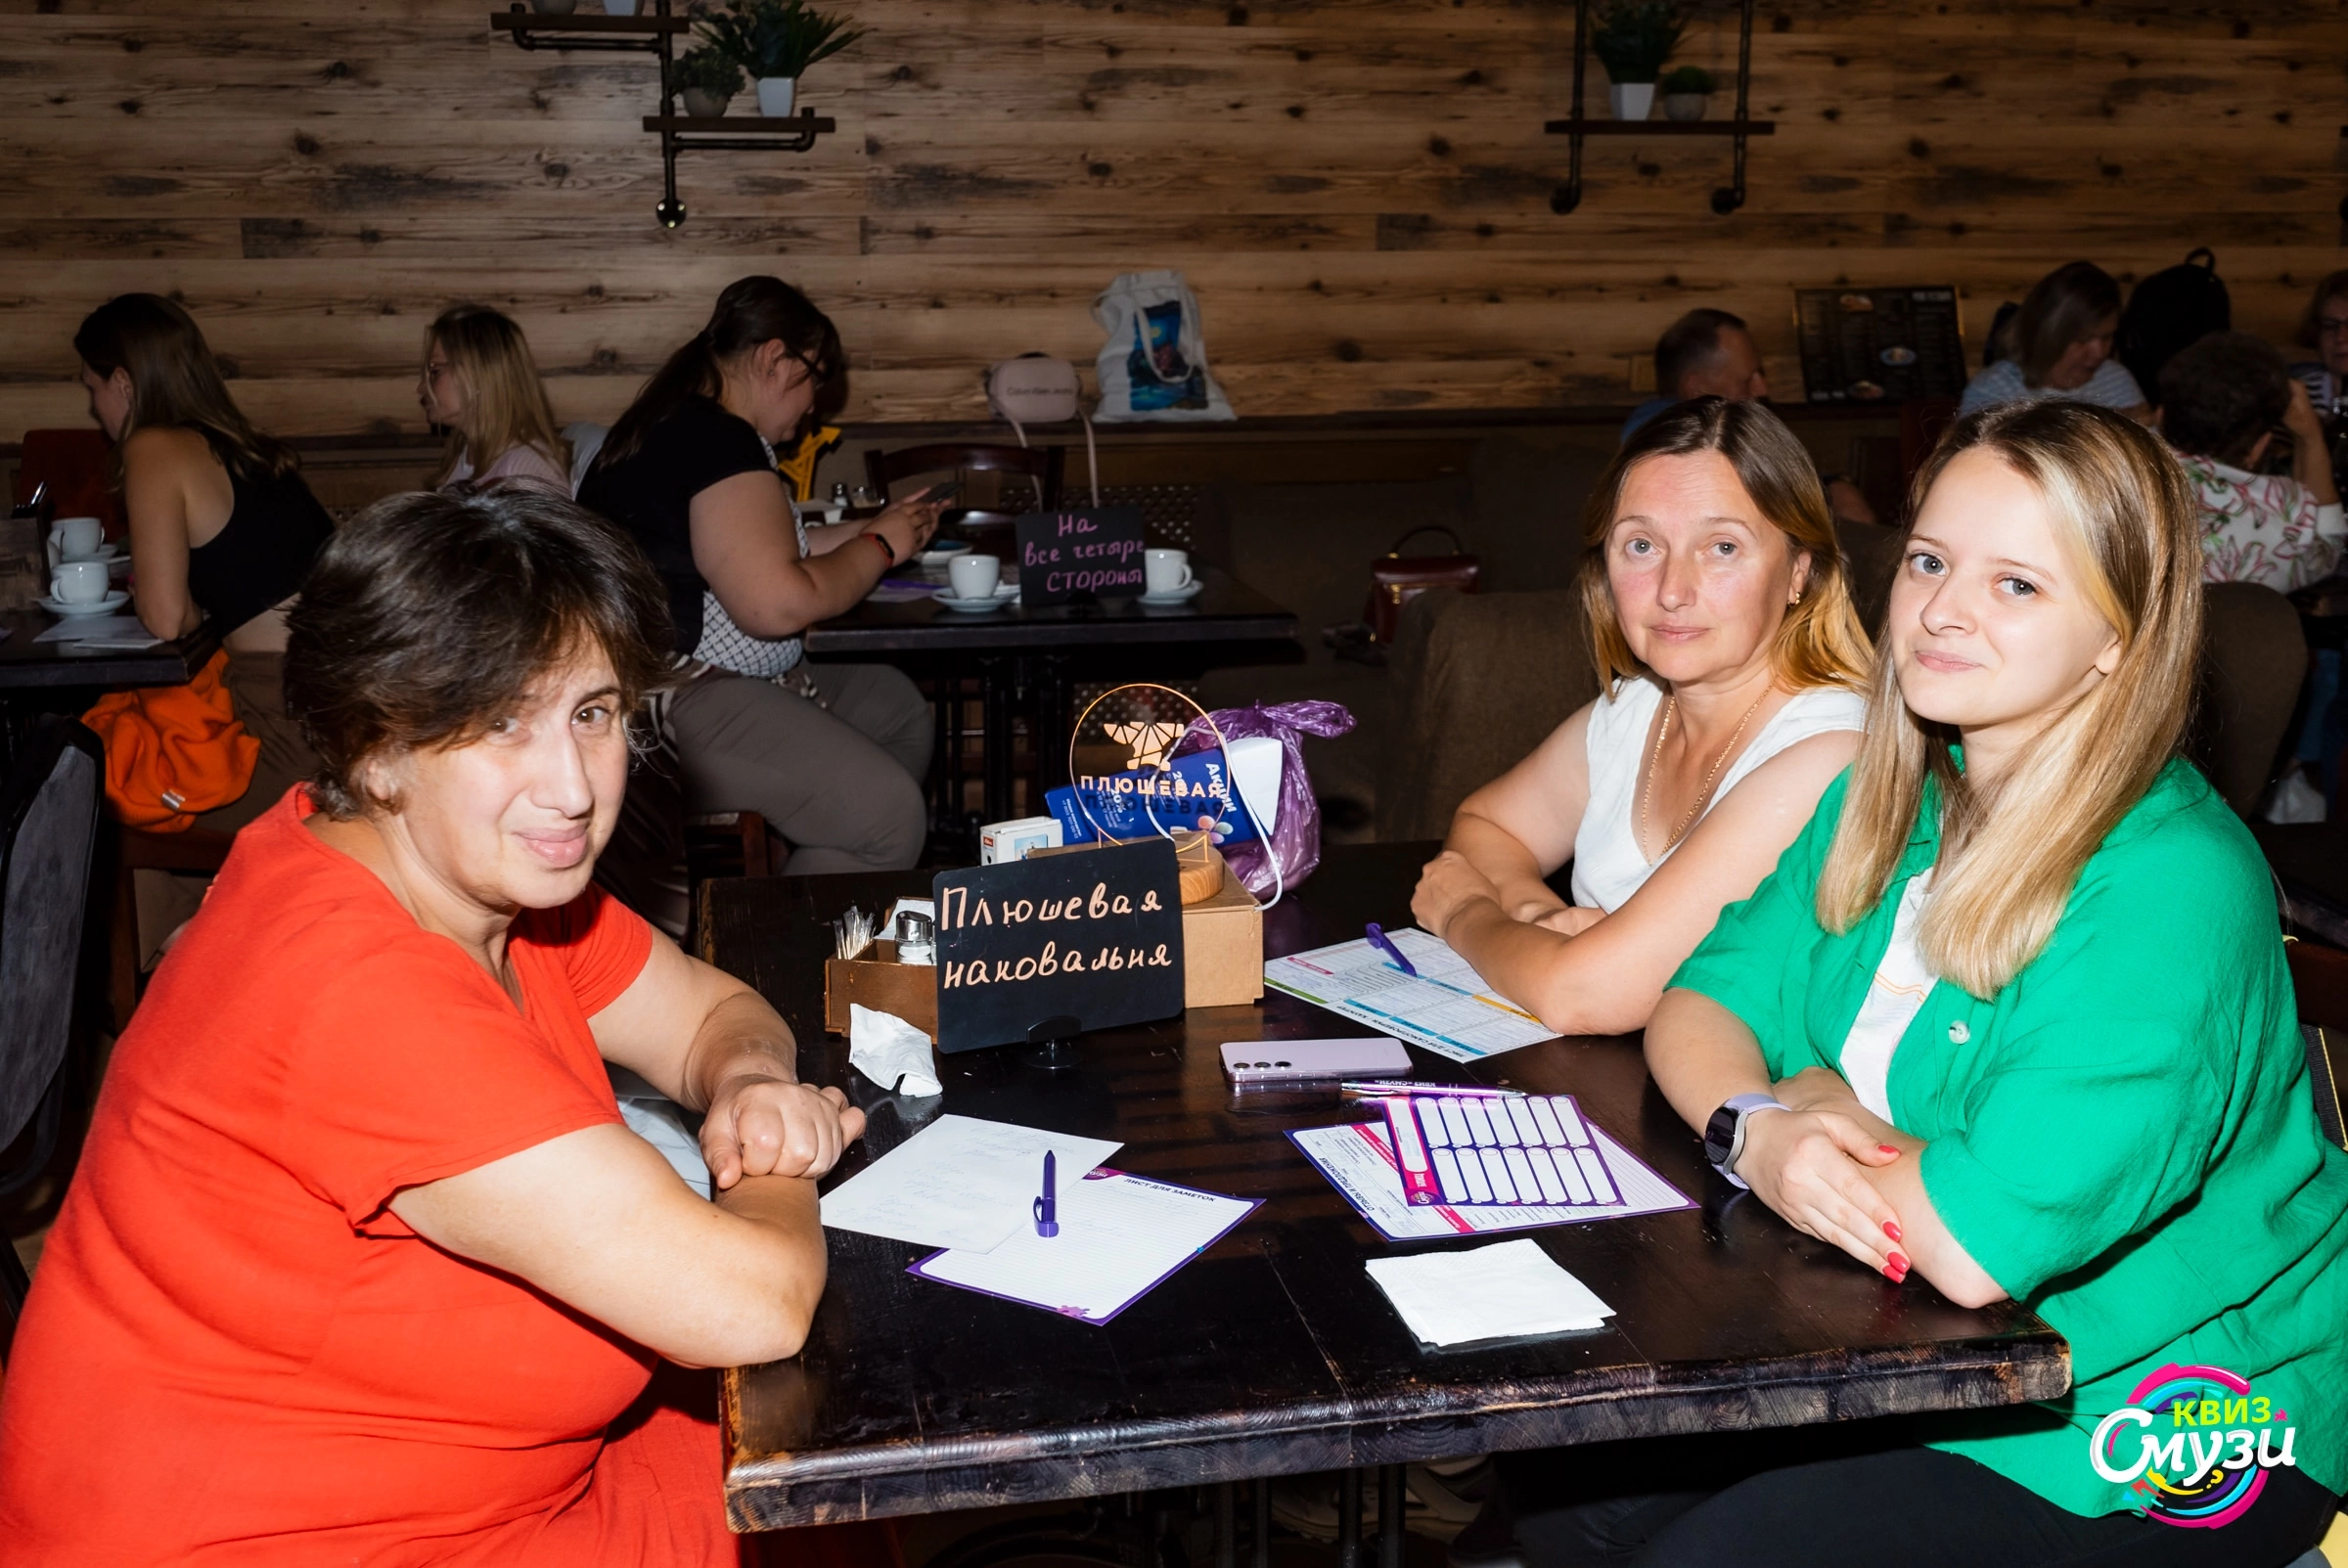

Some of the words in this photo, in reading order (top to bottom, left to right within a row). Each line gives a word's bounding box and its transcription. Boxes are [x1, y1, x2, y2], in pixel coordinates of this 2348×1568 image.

[1059, 514, 1098, 537] На
[1080, 775, 1220, 798] ПЛЮШЕВАЯ
[941, 882, 1163, 930] Плюшевая
[943, 941, 1172, 989] наковальня
[1124, 1178, 1151, 1187] ЛИСТ
[1150, 1184, 1172, 1192] ДЛЯ
[1172, 1188, 1216, 1202] ЗАМЕТОК
